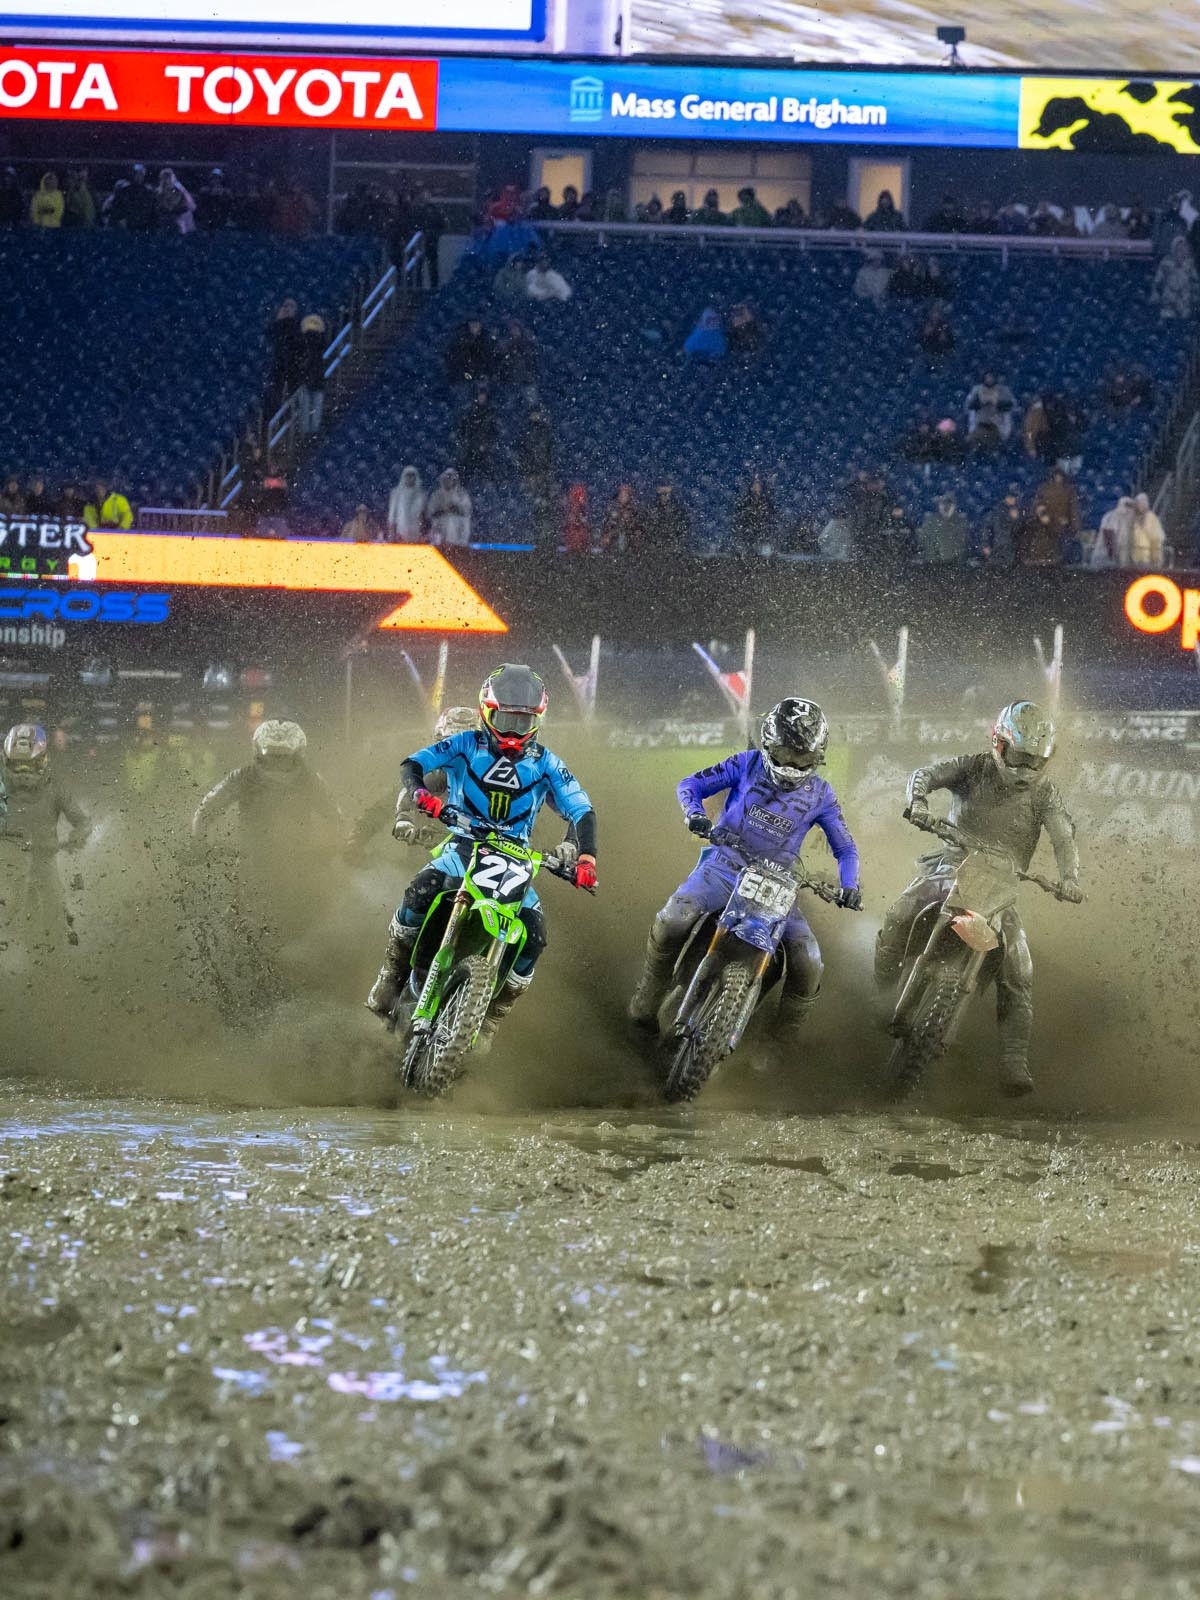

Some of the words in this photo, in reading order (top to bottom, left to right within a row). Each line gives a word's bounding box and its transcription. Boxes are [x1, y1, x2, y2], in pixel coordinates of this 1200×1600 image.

[165, 65, 423, 119] TOYOTA
[611, 92, 675, 119] Mass
[680, 94, 777, 122] General
[782, 97, 887, 129] Brigham
[472, 855, 530, 896] 27
